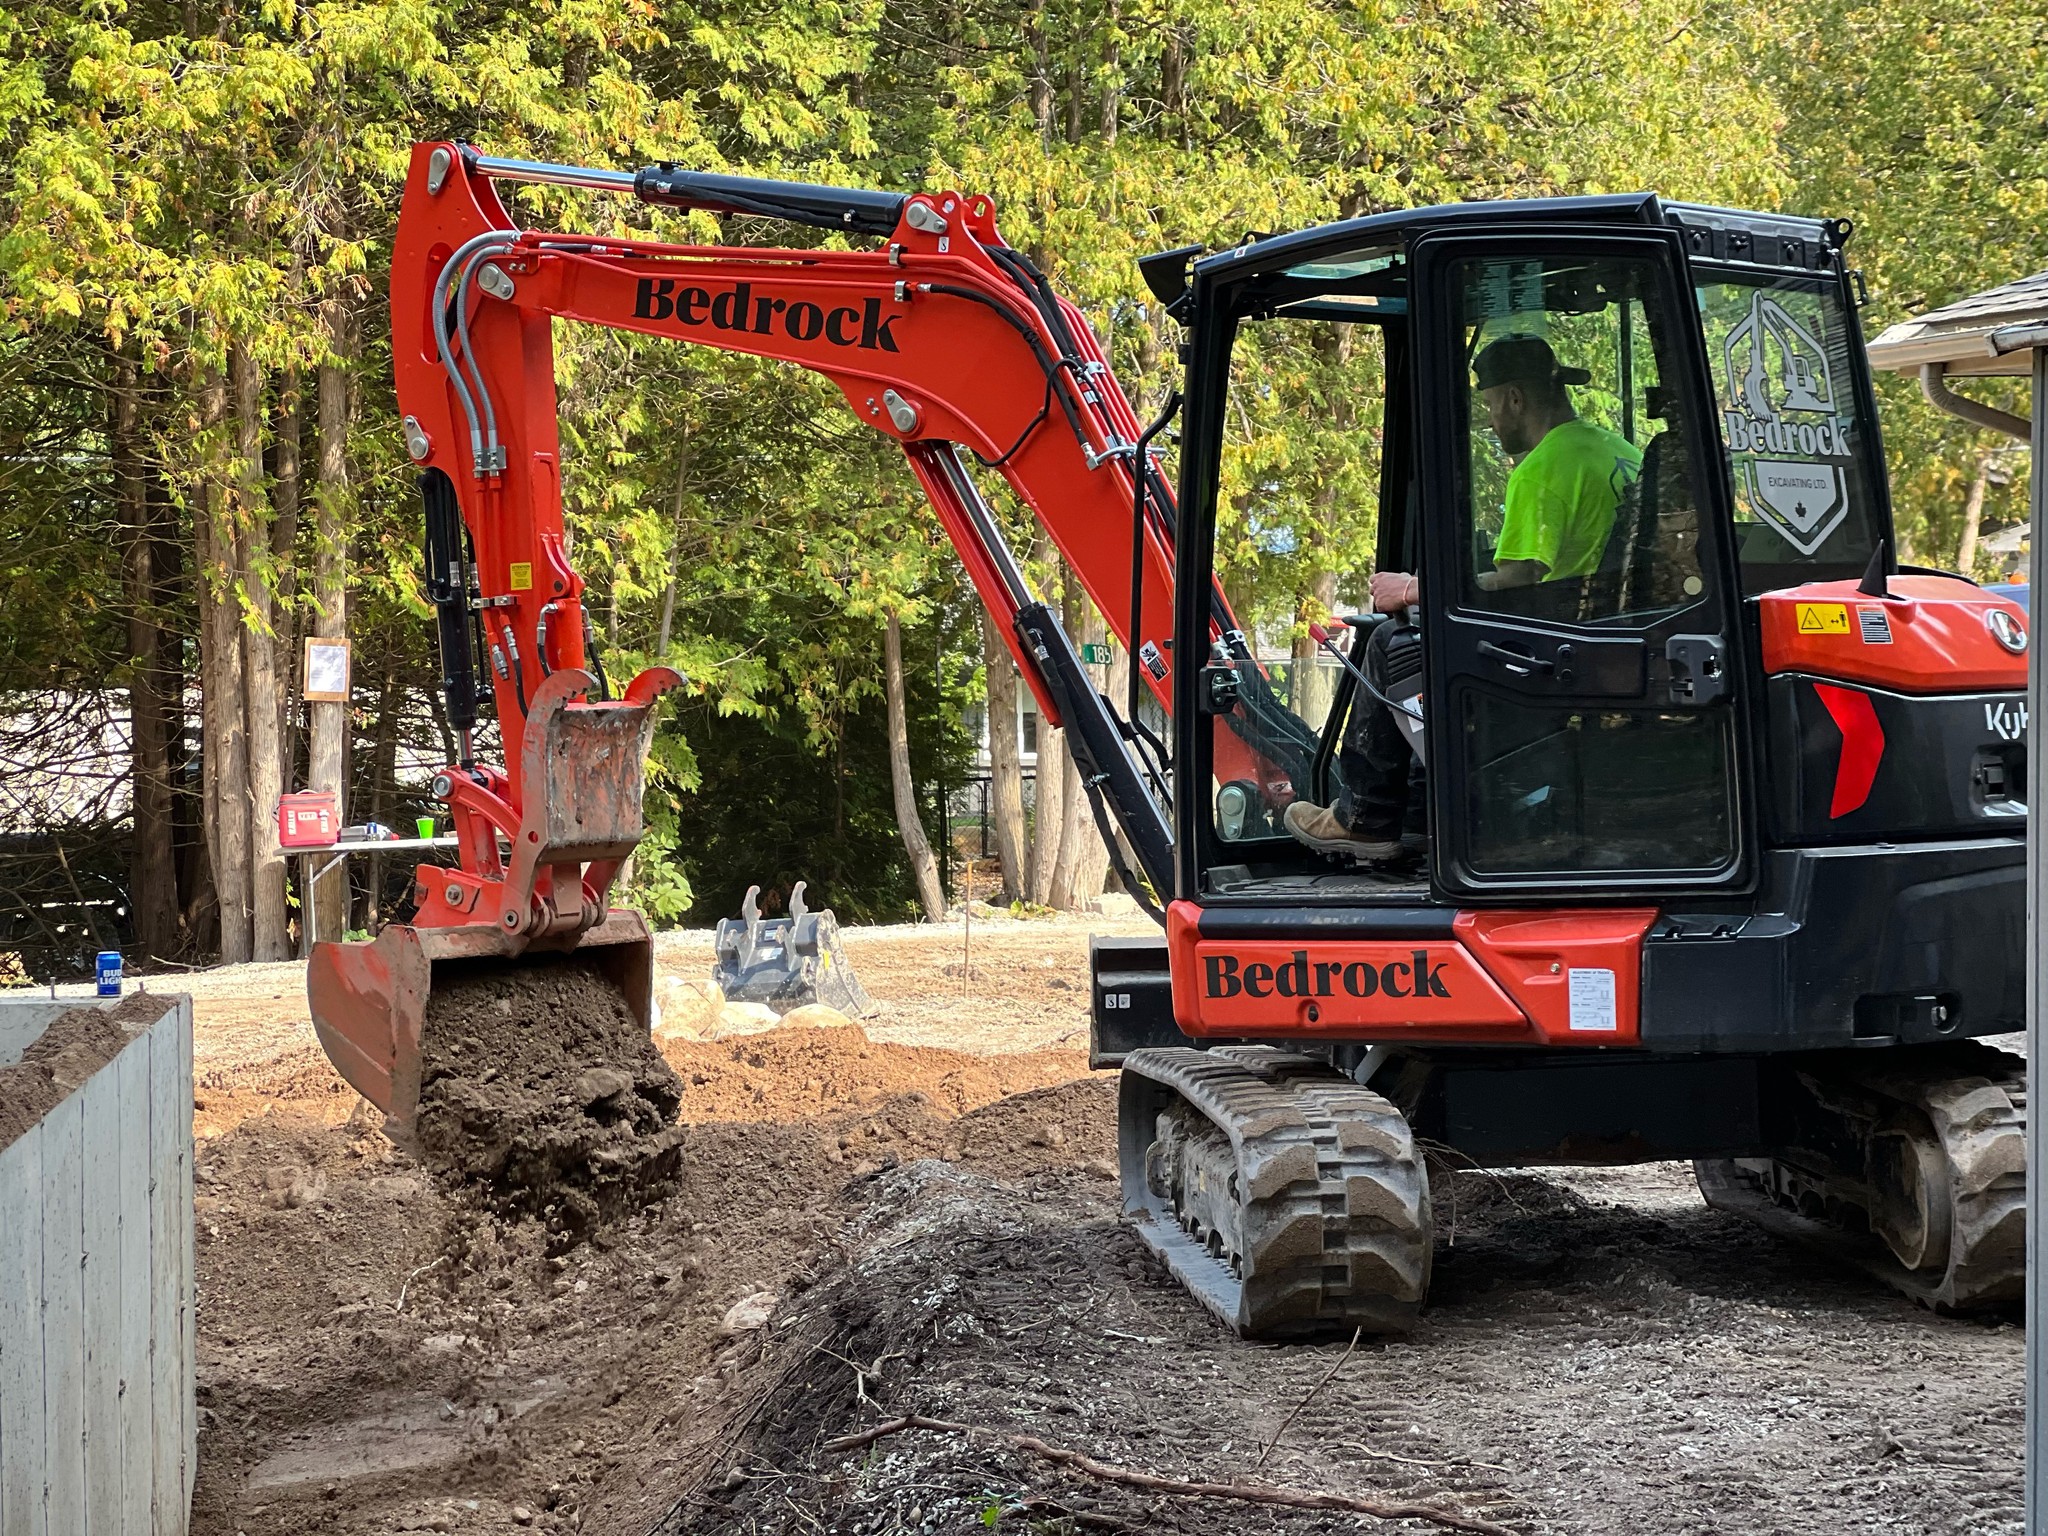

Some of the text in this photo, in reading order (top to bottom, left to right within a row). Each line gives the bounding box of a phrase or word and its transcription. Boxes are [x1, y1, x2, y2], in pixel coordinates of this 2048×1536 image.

[631, 278, 902, 353] Bedrock
[1724, 410, 1851, 457] Bedrock
[1768, 476, 1812, 489] EXCAVATING
[1092, 645, 1111, 664] 185
[103, 969, 122, 977] BUD
[1202, 950, 1452, 999] Bedrock
